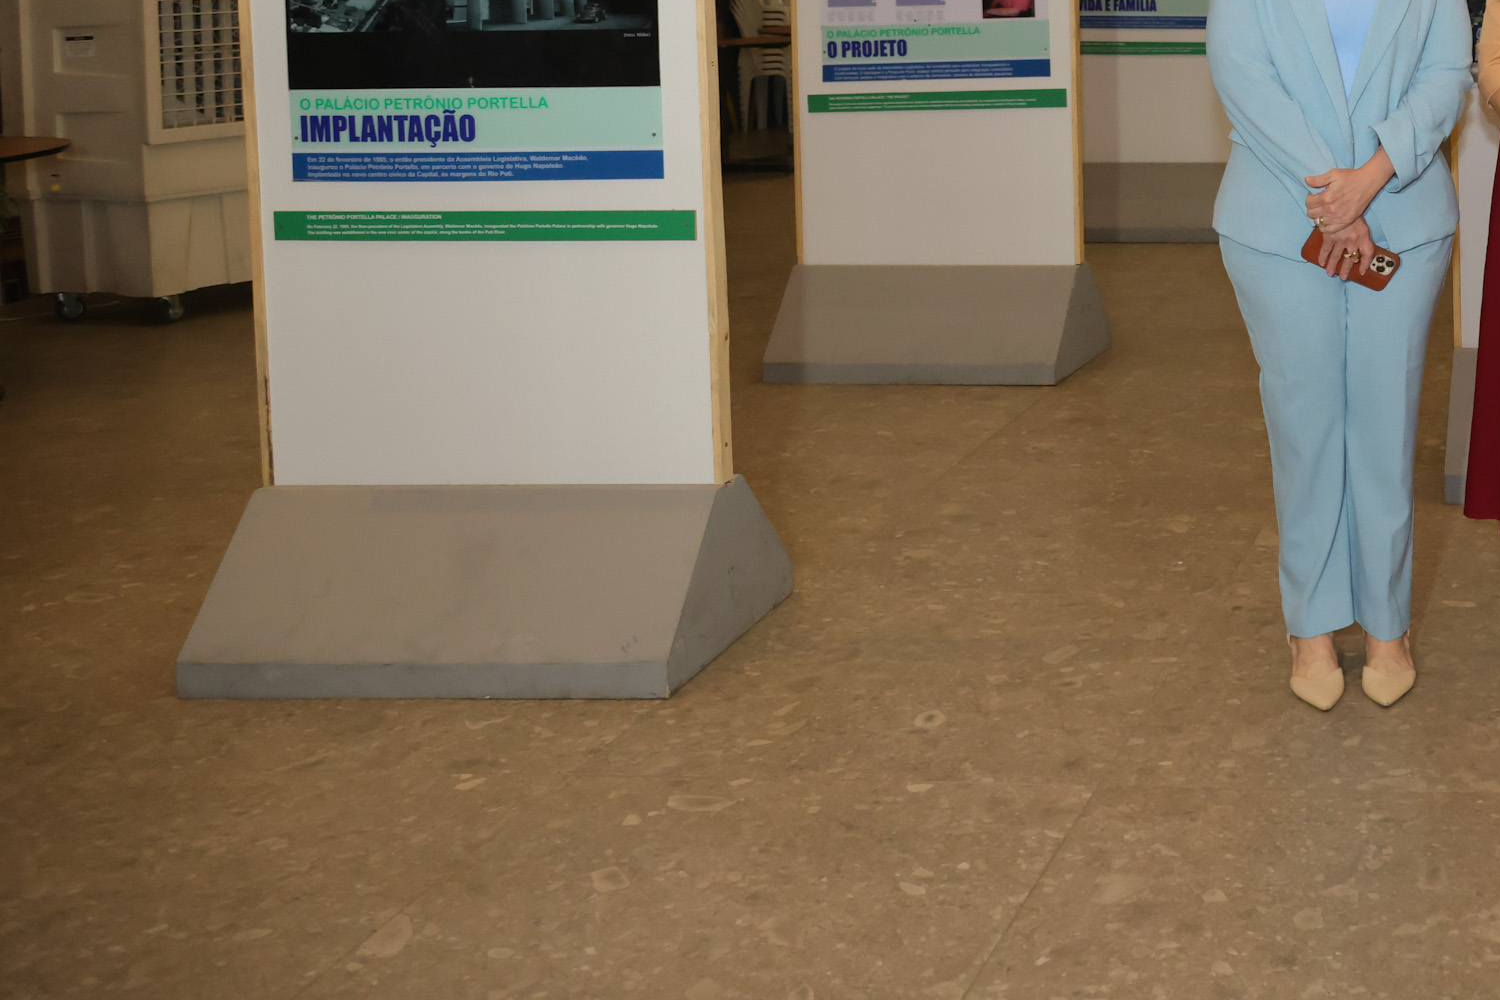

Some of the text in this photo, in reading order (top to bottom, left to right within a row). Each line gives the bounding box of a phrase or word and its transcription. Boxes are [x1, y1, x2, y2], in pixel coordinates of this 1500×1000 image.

[827, 26, 980, 39] O PALÁCIO PETRÔNIO PORTELLA
[827, 39, 907, 58] O PROJETO
[300, 95, 548, 110] O PALÁCIO PETRÔNIO PORTELLA
[300, 108, 476, 147] IMPLANTAÇÃO
